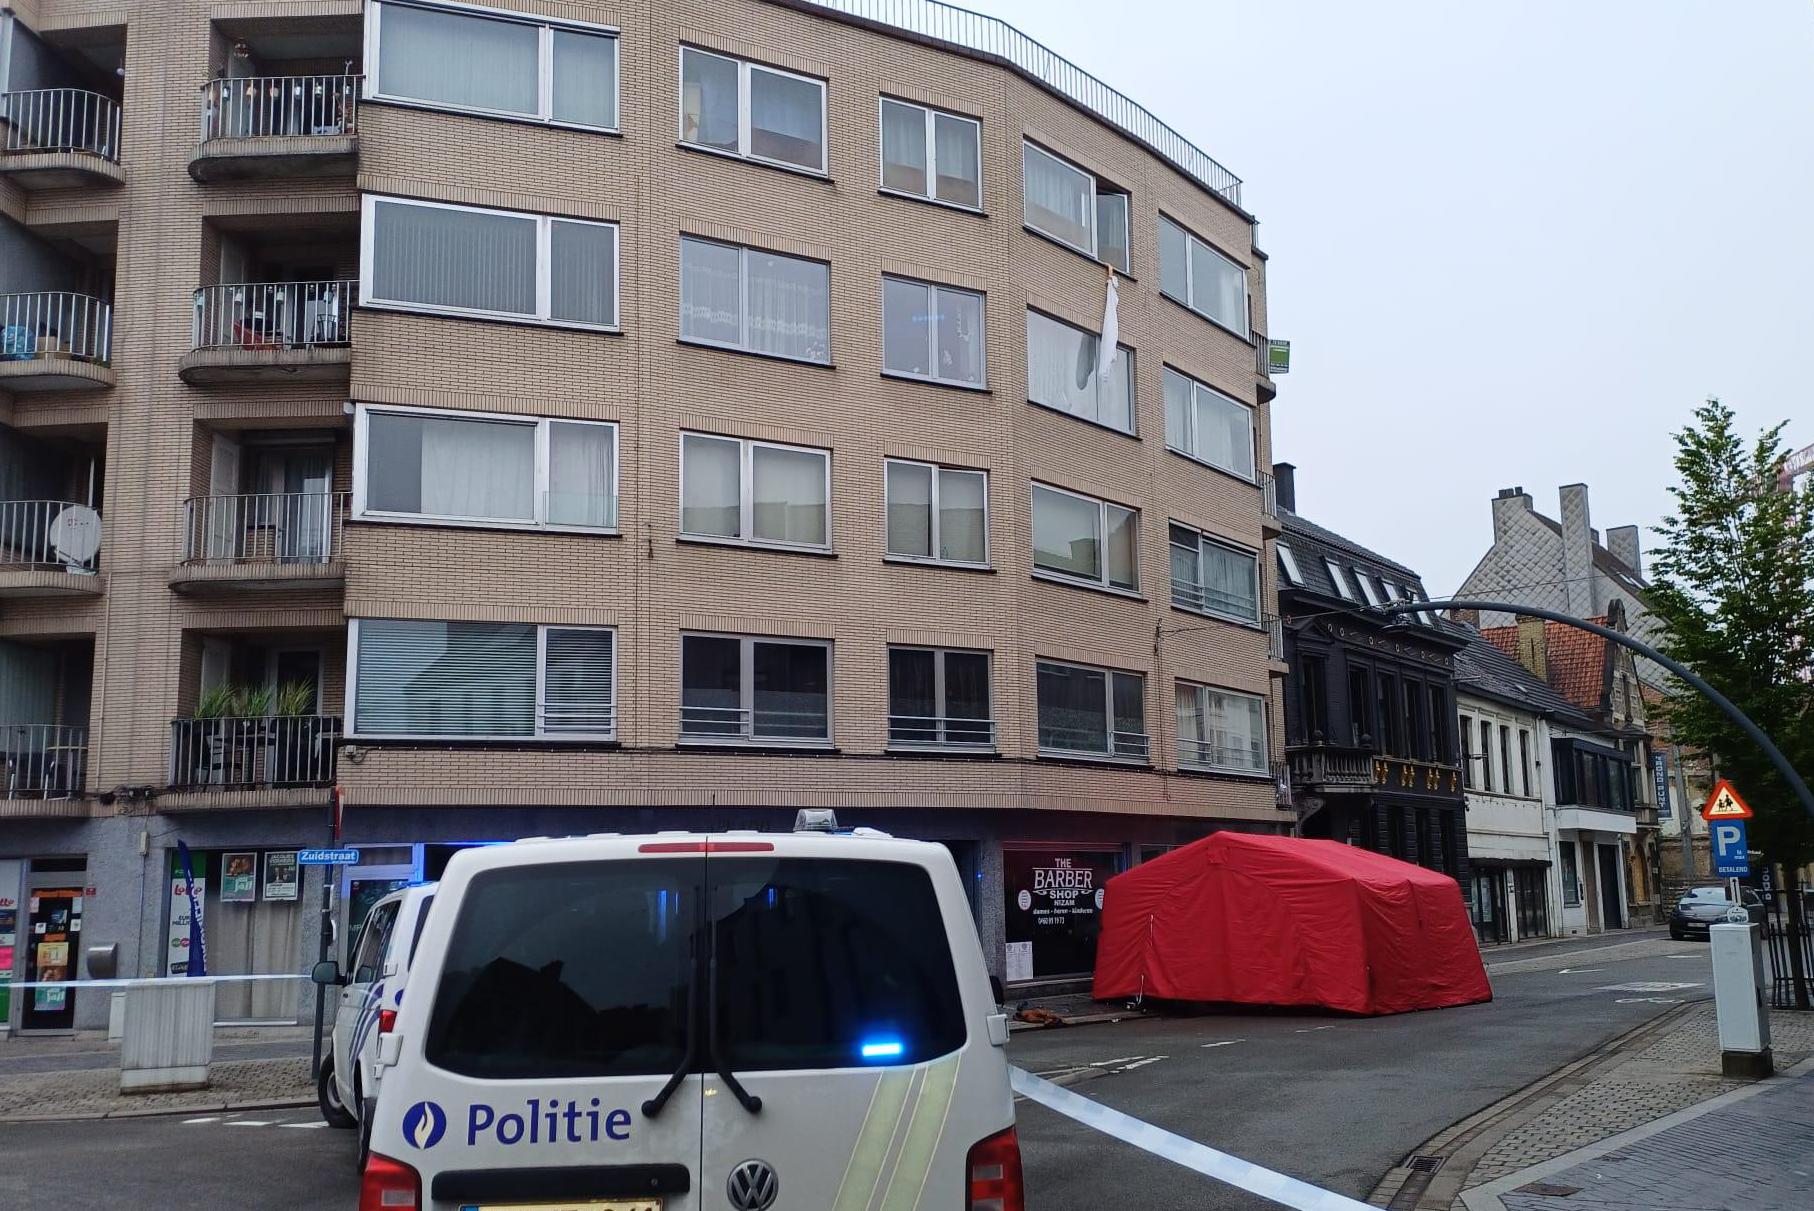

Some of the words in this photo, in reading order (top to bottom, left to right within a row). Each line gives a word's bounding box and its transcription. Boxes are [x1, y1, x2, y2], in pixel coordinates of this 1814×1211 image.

[1716, 825, 1741, 857] P
[301, 851, 356, 861] Zuidstraat
[1054, 857, 1072, 868] THE
[1034, 870, 1093, 889] BARBER
[1049, 890, 1079, 899] SHOP
[467, 1097, 632, 1146] Politie
